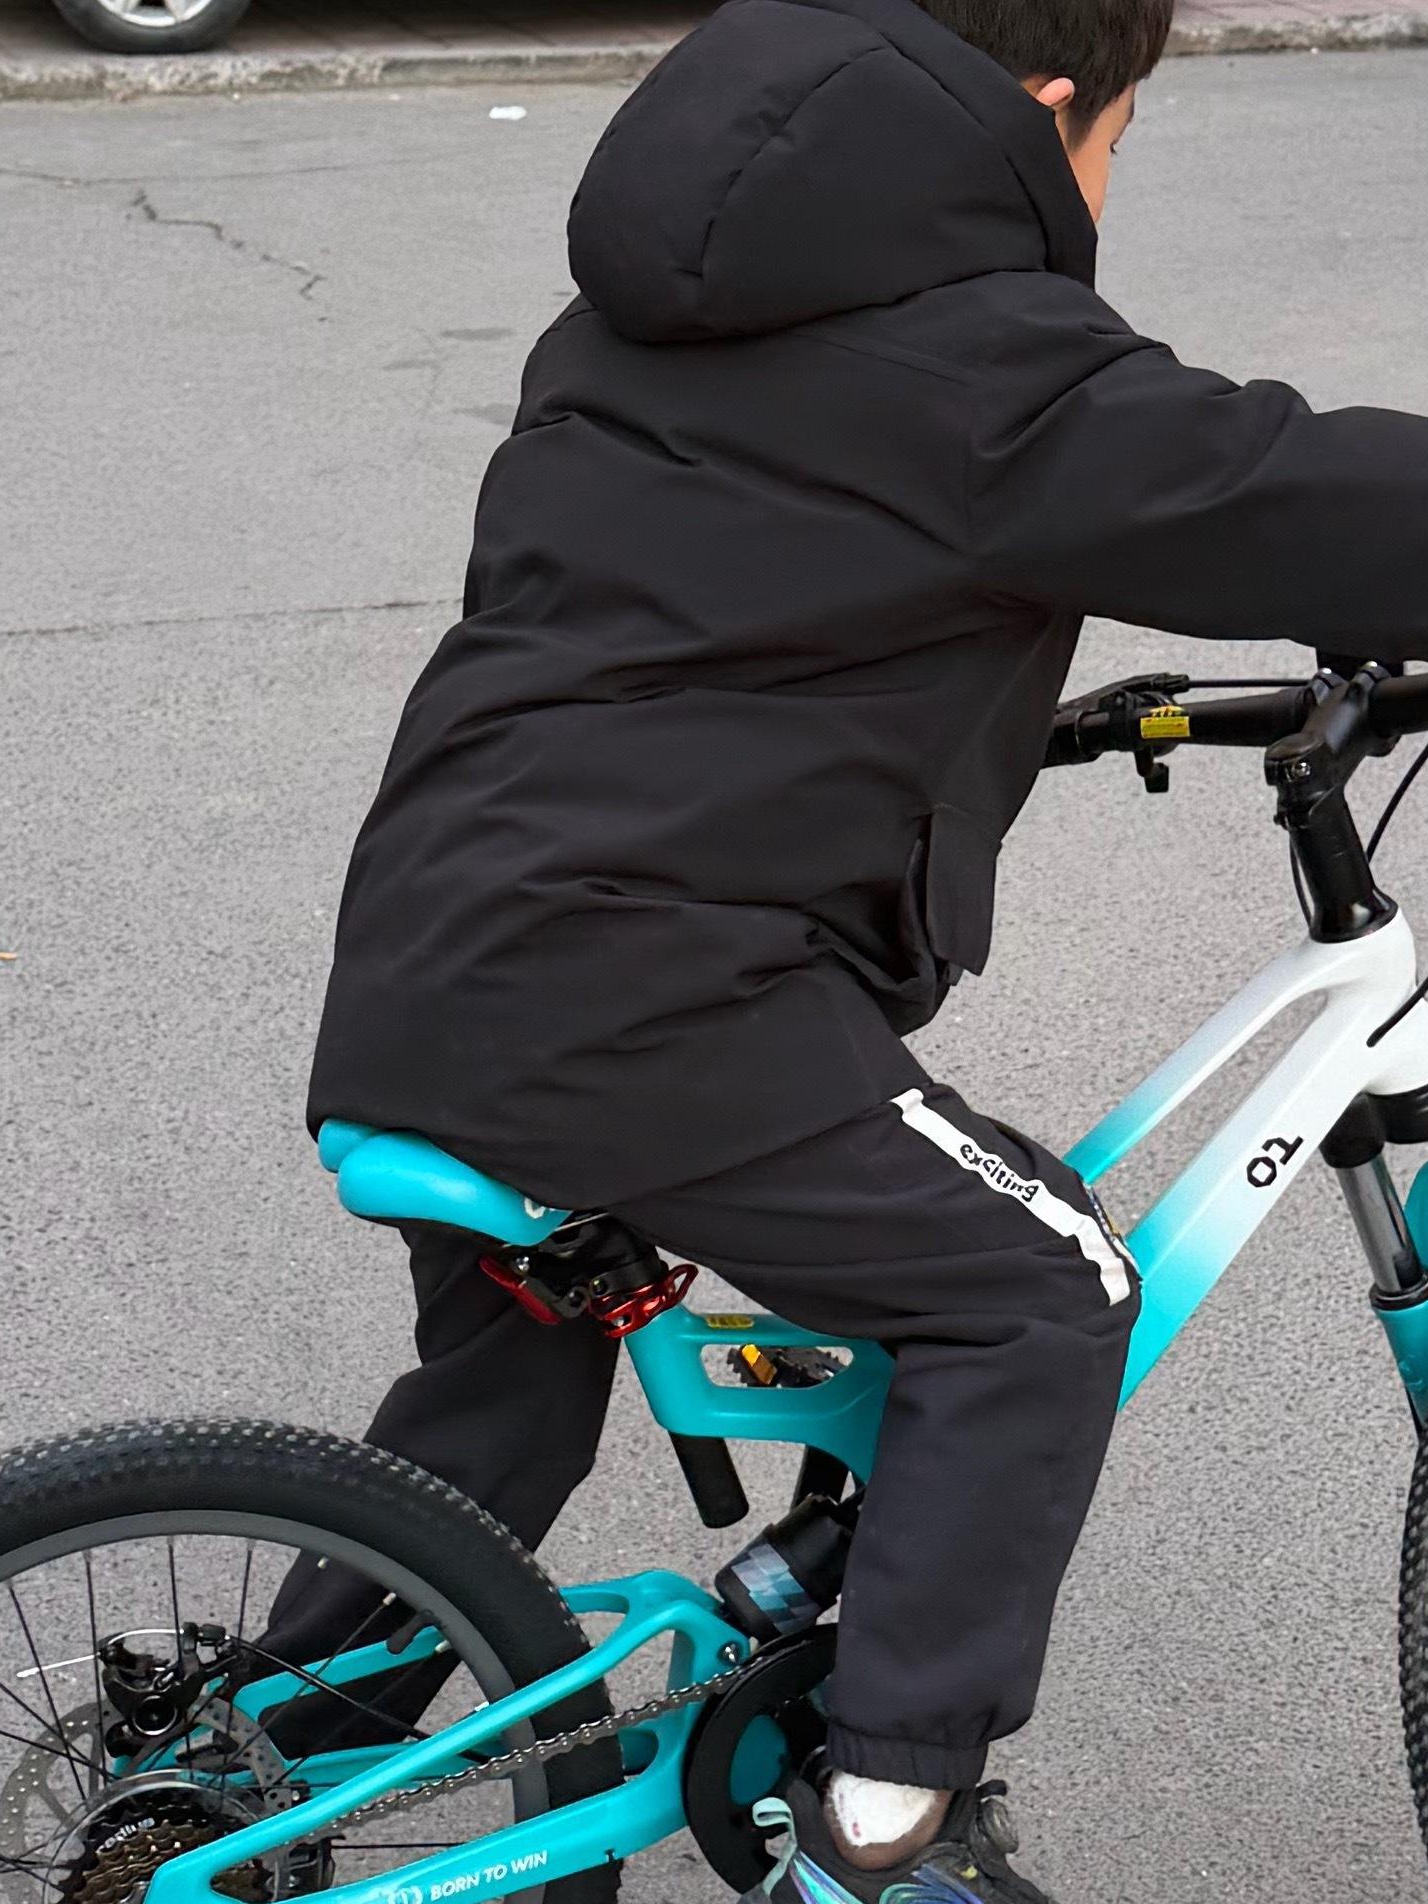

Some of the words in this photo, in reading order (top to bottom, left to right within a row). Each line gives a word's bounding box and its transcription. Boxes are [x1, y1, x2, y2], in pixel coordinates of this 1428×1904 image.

[959, 1142, 1040, 1203] exciting
[430, 1870, 480, 1902] BORN
[484, 1863, 508, 1883] TO
[511, 1850, 548, 1875] WIN
